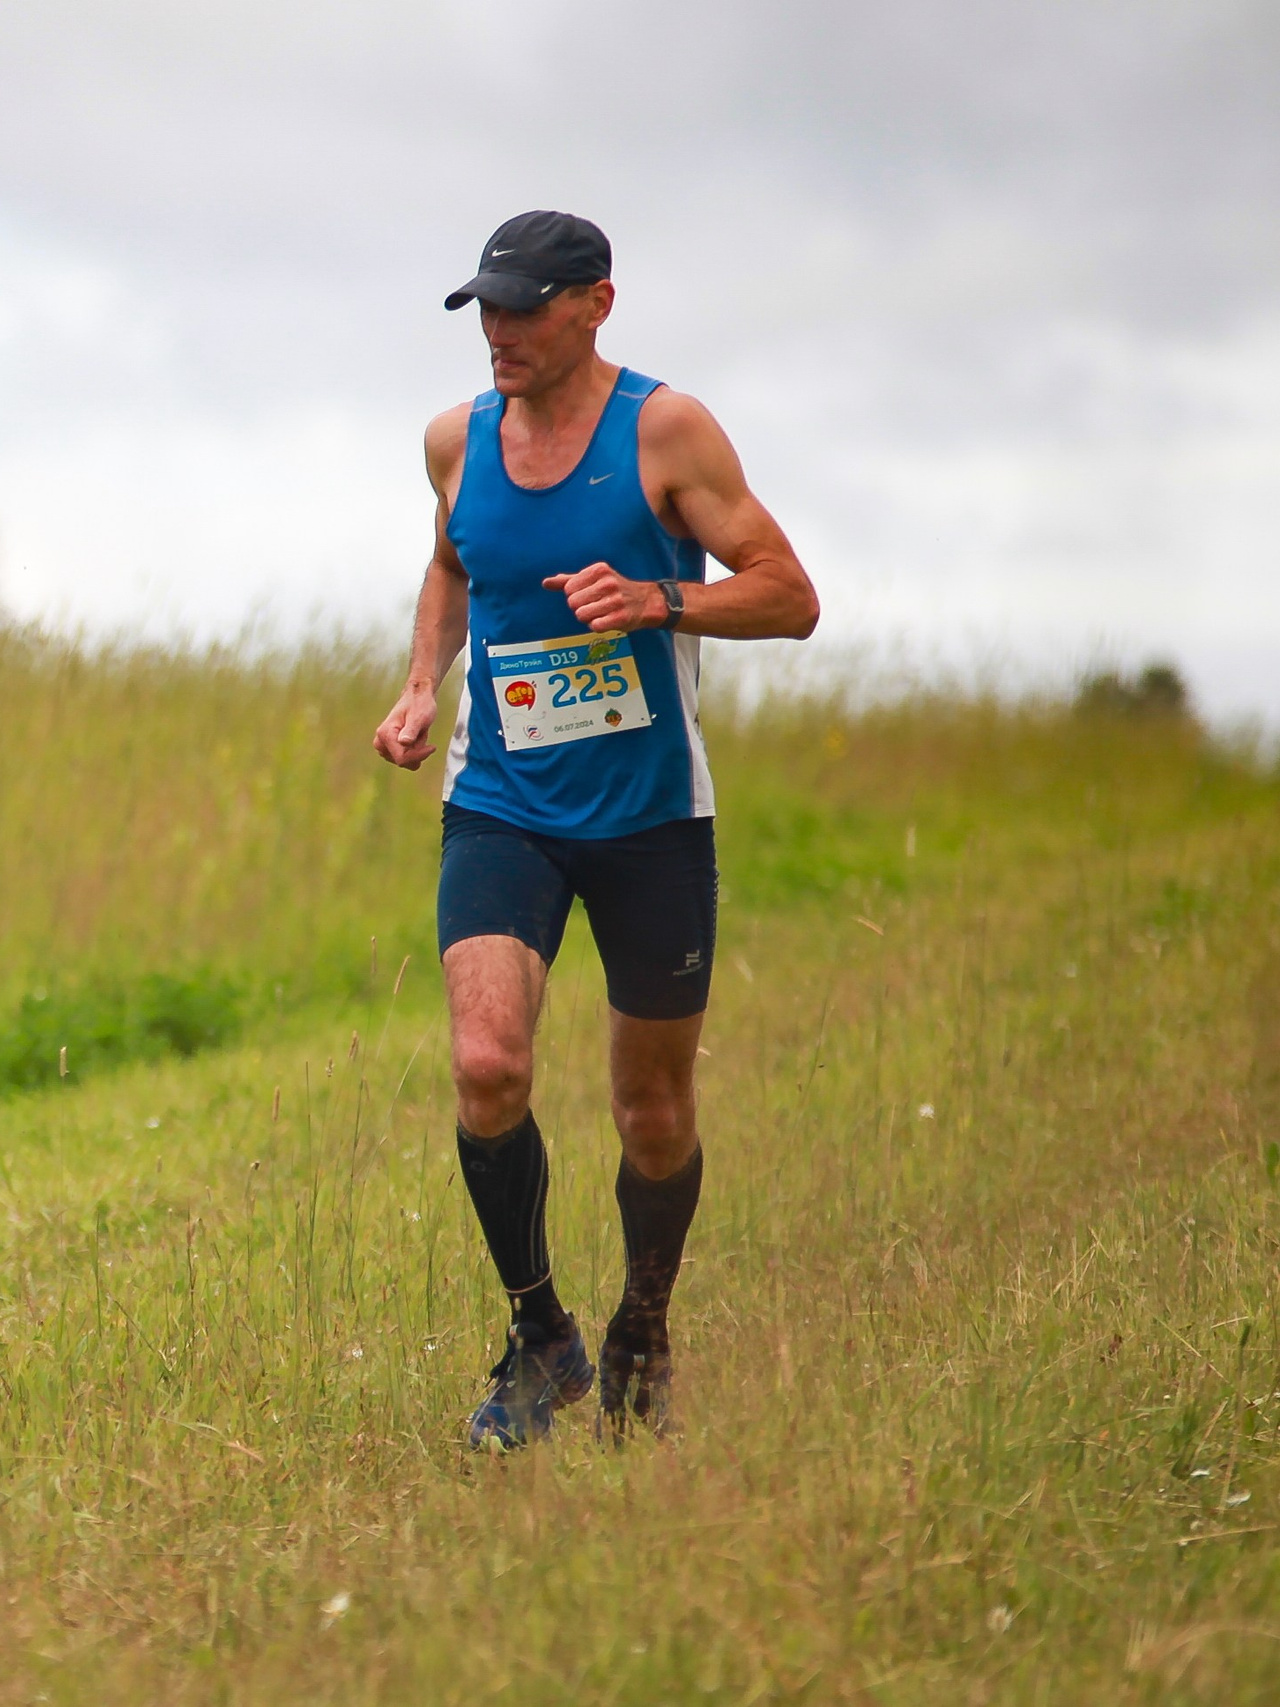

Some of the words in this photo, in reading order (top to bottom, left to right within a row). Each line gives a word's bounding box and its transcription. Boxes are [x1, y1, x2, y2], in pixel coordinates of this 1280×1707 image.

[549, 651, 578, 666] D19
[548, 663, 629, 709] 225
[554, 720, 594, 732] 06.07.2024
